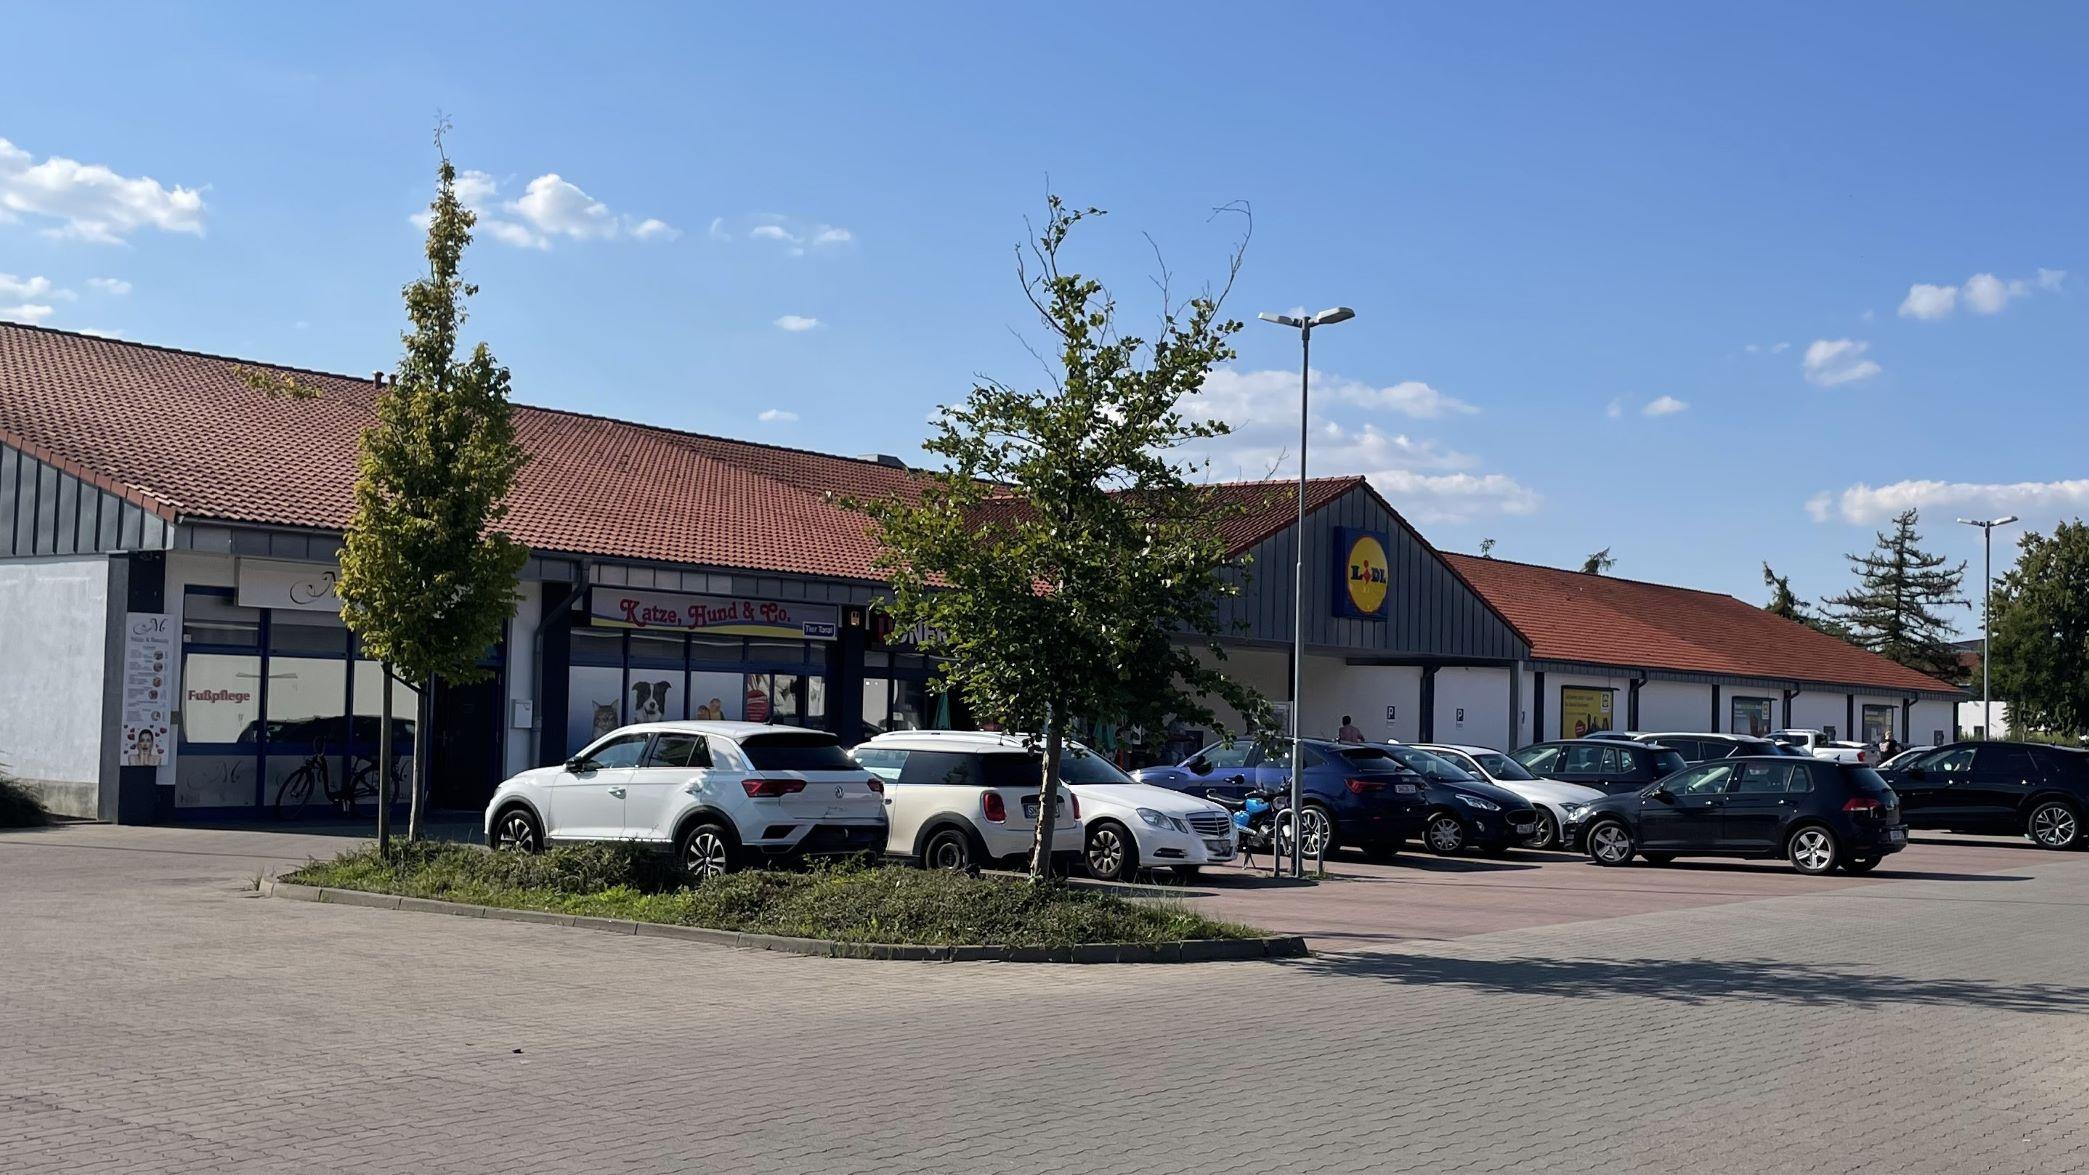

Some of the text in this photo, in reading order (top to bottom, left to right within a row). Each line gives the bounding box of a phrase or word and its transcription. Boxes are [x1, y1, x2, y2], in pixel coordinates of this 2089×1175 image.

[619, 599, 791, 630] Katze, Hund & Co.
[188, 689, 251, 704] Fußpflege
